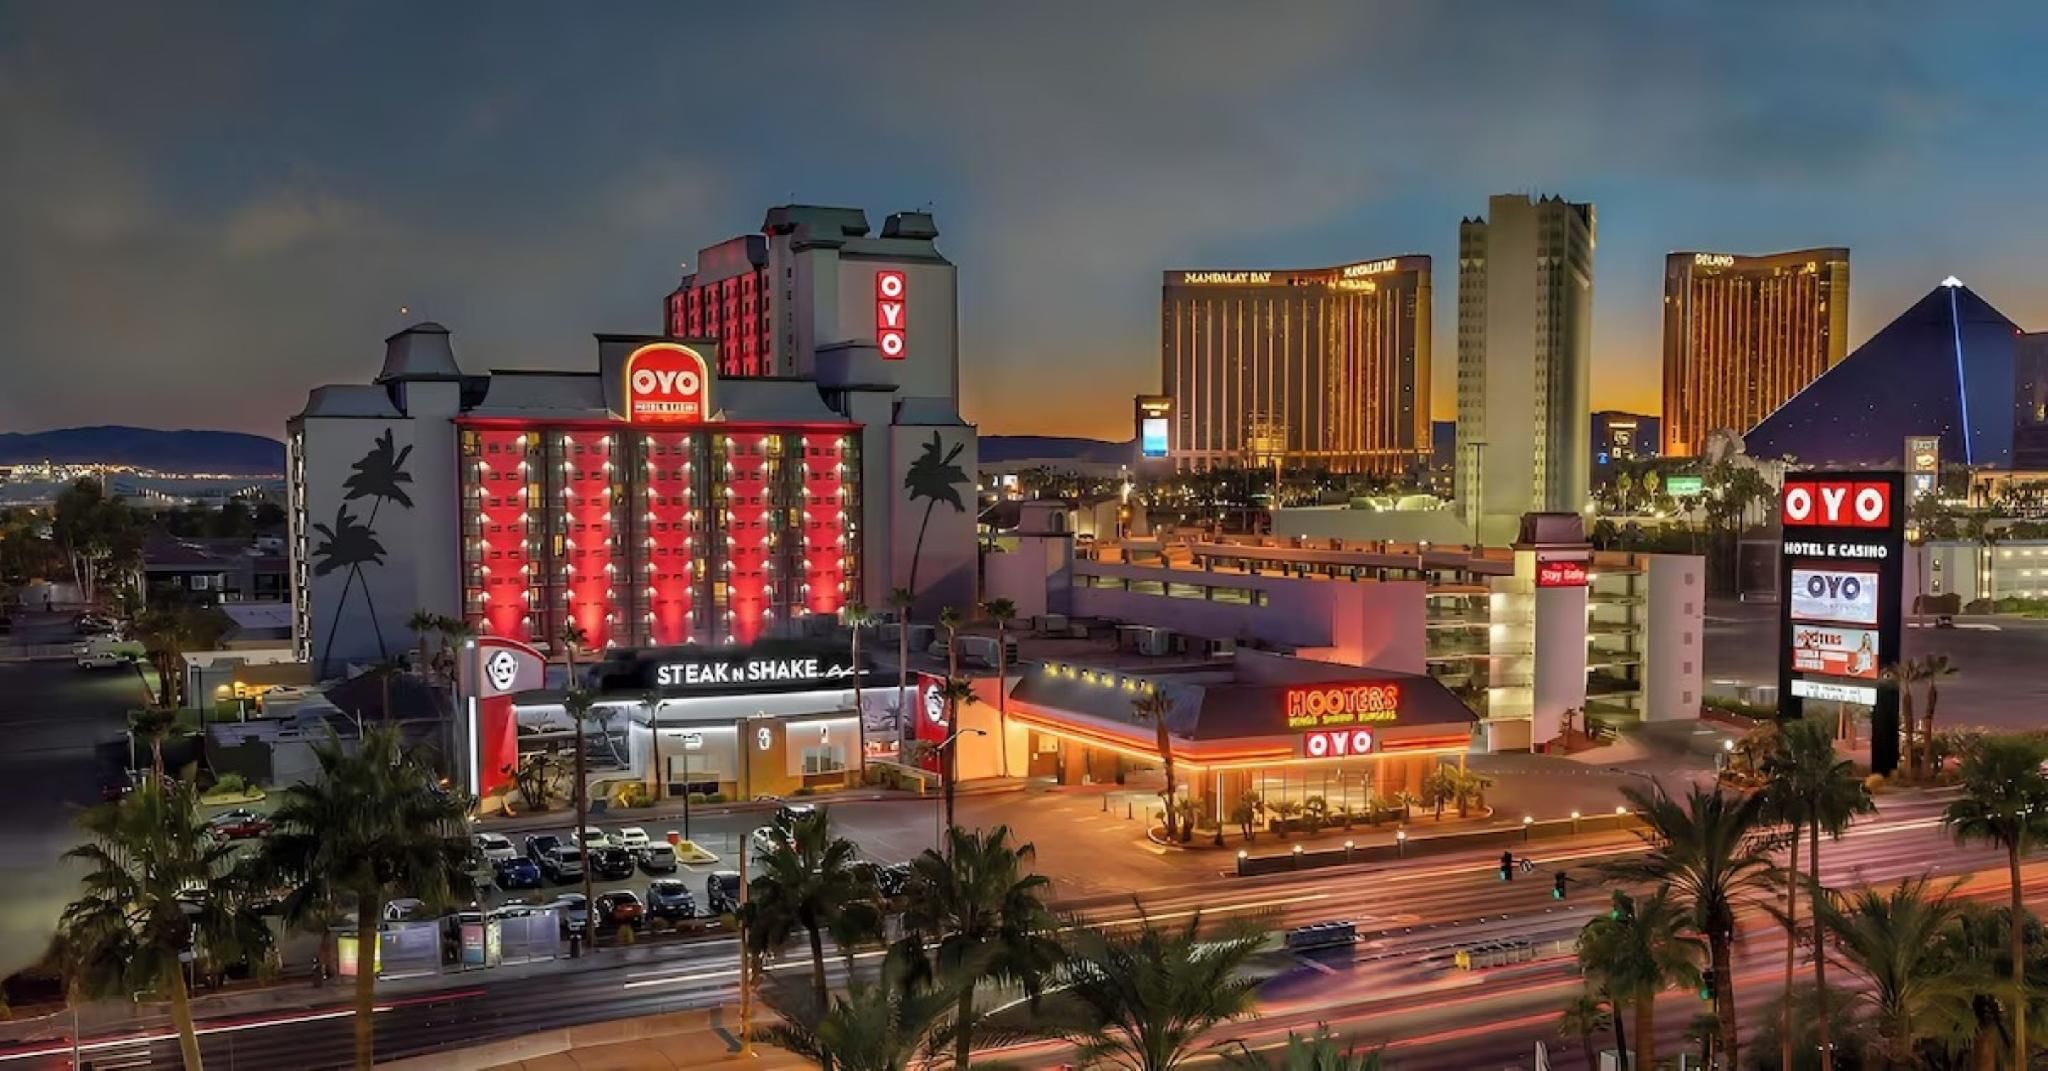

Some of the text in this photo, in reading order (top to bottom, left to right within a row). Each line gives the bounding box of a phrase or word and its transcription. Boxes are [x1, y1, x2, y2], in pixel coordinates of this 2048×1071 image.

[1695, 253, 1734, 267] DELANO
[1184, 271, 1249, 284] MANDALAY
[1250, 271, 1272, 284] BAY
[881, 275, 903, 356] OYO
[632, 369, 699, 395] OYO
[1786, 487, 1883, 521] OYO
[1784, 542, 1825, 556] HOTEL
[1840, 544, 1888, 558] CASINO
[1808, 575, 1861, 600] OYO
[657, 663, 729, 685] STEAK
[749, 659, 818, 681] SHAKE
[1288, 686, 1398, 717] HOOTERS
[1309, 730, 1371, 756] OYO
